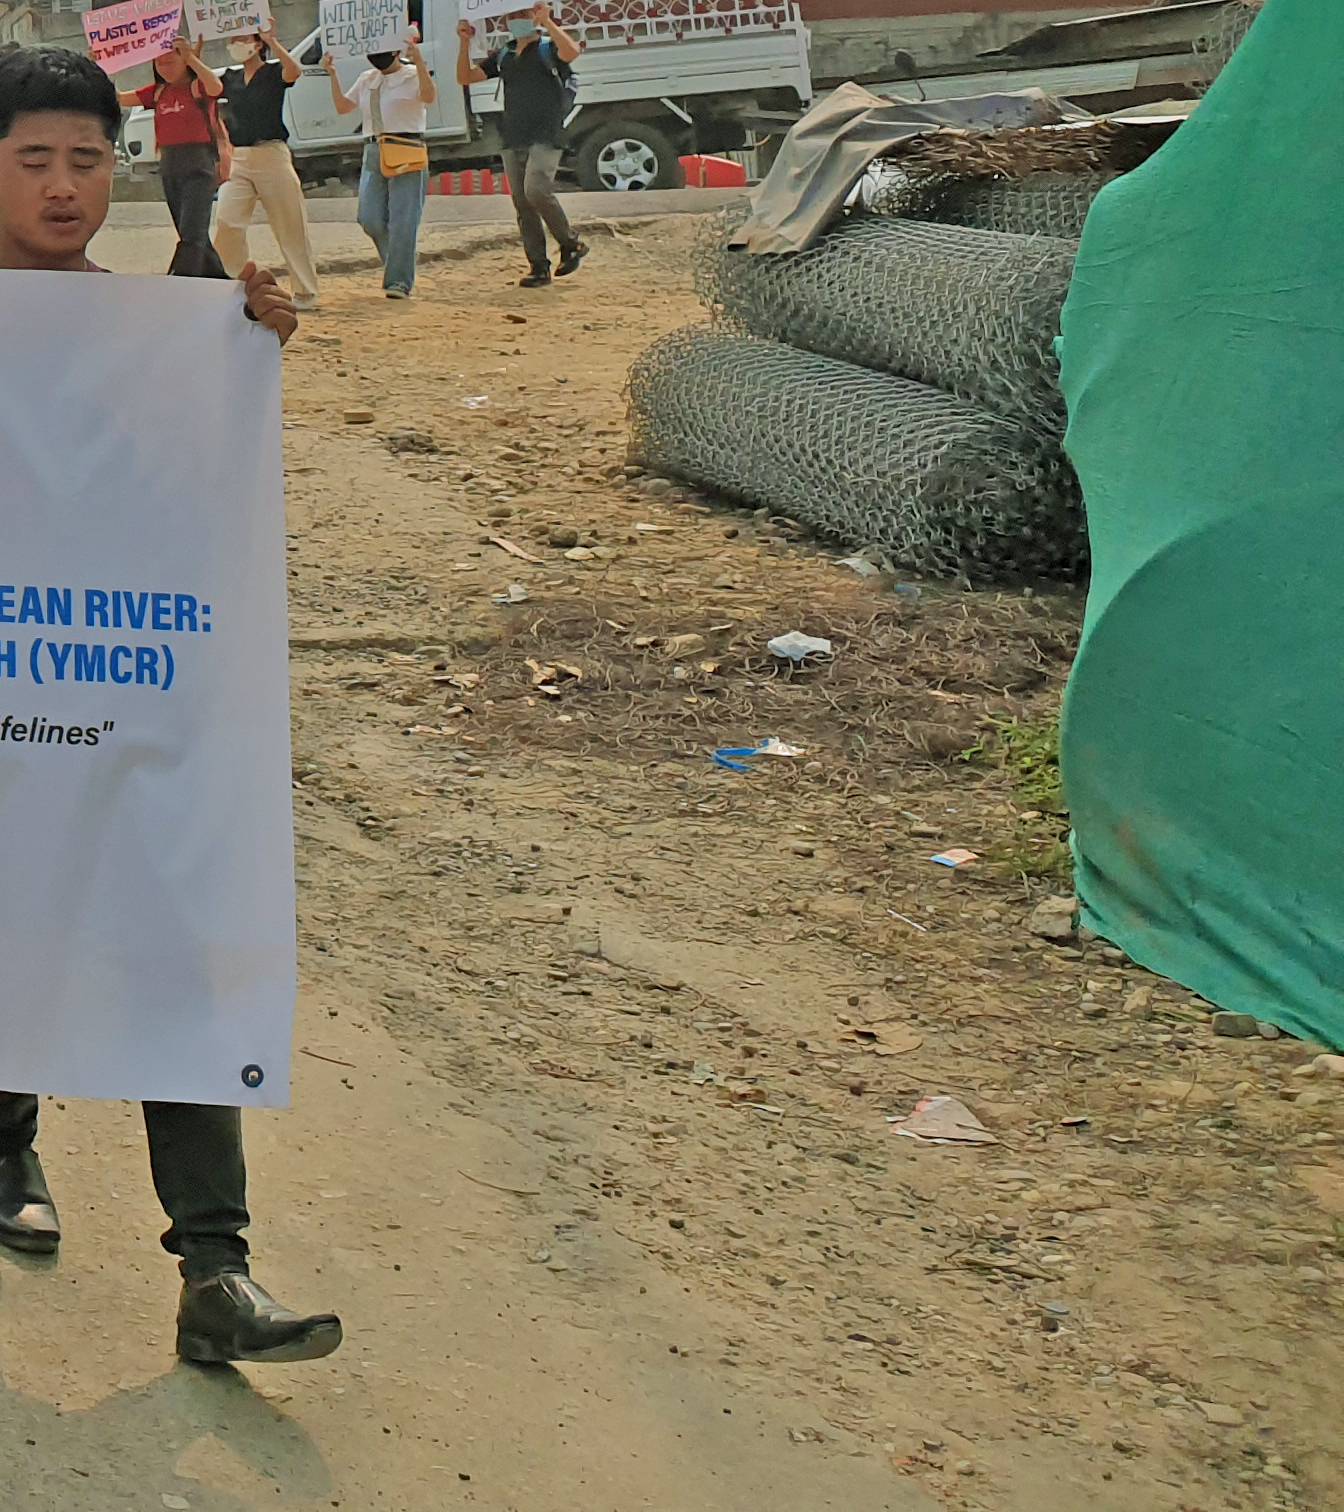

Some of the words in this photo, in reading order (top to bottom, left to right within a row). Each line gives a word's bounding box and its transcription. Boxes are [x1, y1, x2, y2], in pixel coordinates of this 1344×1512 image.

[89, 21, 137, 45] PLASTIC
[143, 8, 180, 31] BEFORE
[103, 41, 129, 58] WIPE
[131, 37, 146, 50] US
[150, 26, 170, 43] OUT
[325, 23, 357, 46] EIA
[348, 40, 380, 57] 2020
[85, 589, 212, 633] RIVER:
[28, 638, 175, 691] (YMCR)
